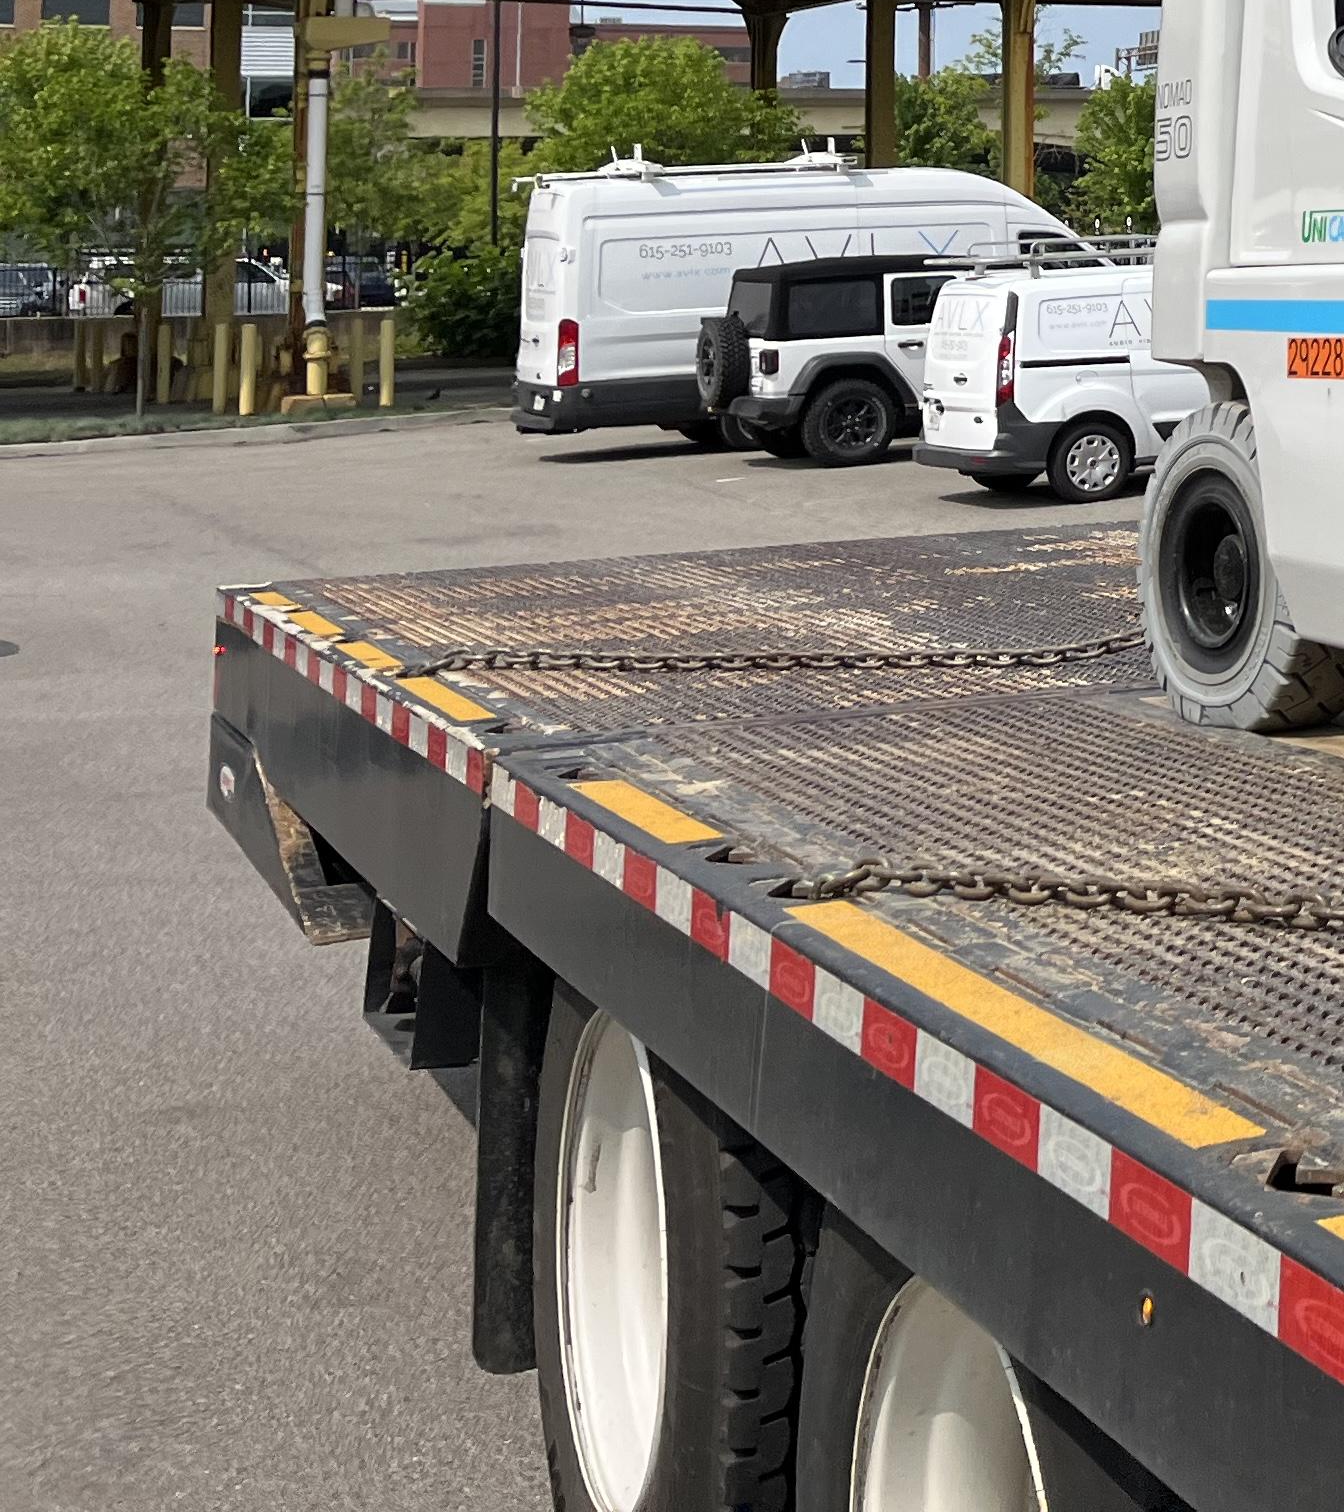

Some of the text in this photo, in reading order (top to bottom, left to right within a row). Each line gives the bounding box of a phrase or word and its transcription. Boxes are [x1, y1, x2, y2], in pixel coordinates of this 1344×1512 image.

[1157, 80, 1193, 109] NOMAD
[1156, 115, 1193, 161] 50
[639, 241, 733, 260] 615-251-9103
[1047, 302, 1108, 315] 615-251-9103
